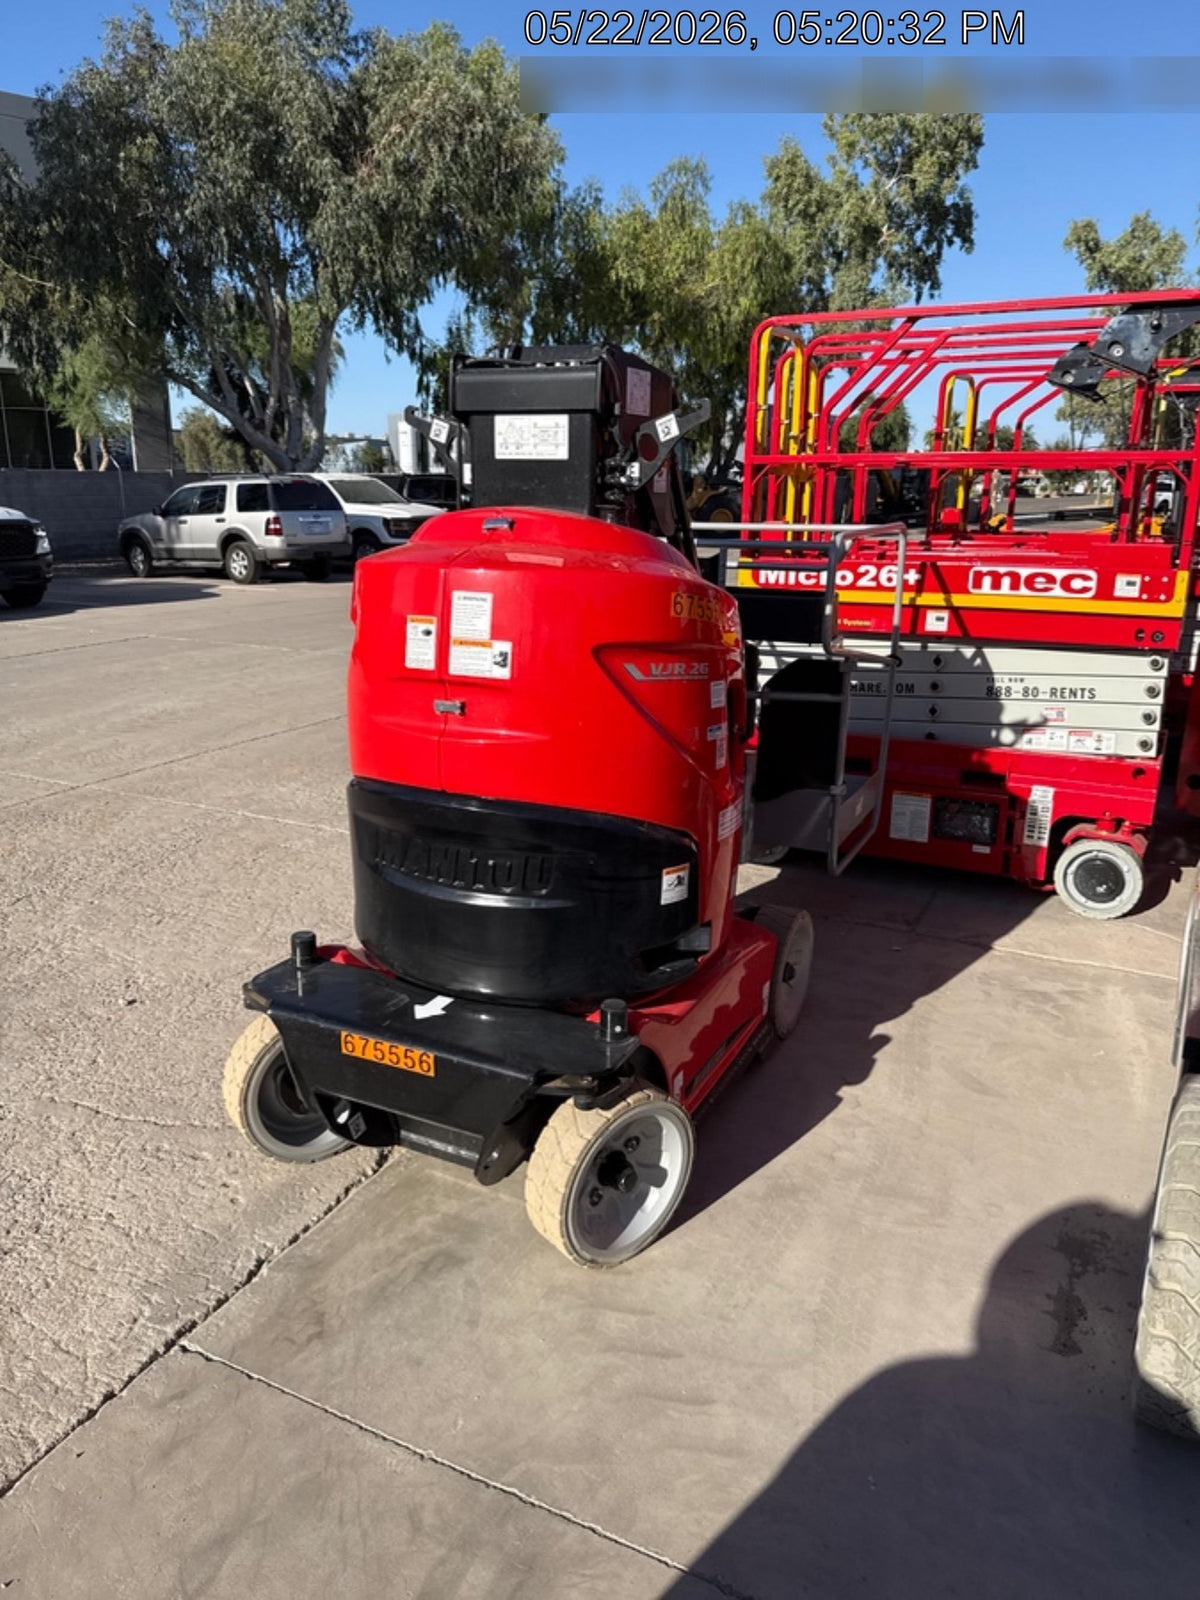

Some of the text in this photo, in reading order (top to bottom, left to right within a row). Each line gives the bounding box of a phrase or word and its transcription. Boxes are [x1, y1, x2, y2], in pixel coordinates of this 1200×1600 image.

[971, 570, 1094, 594] mec
[649, 662, 709, 676] VJR 26
[986, 685, 1097, 700] 888-80-RENTS
[343, 1033, 433, 1074] 675556
